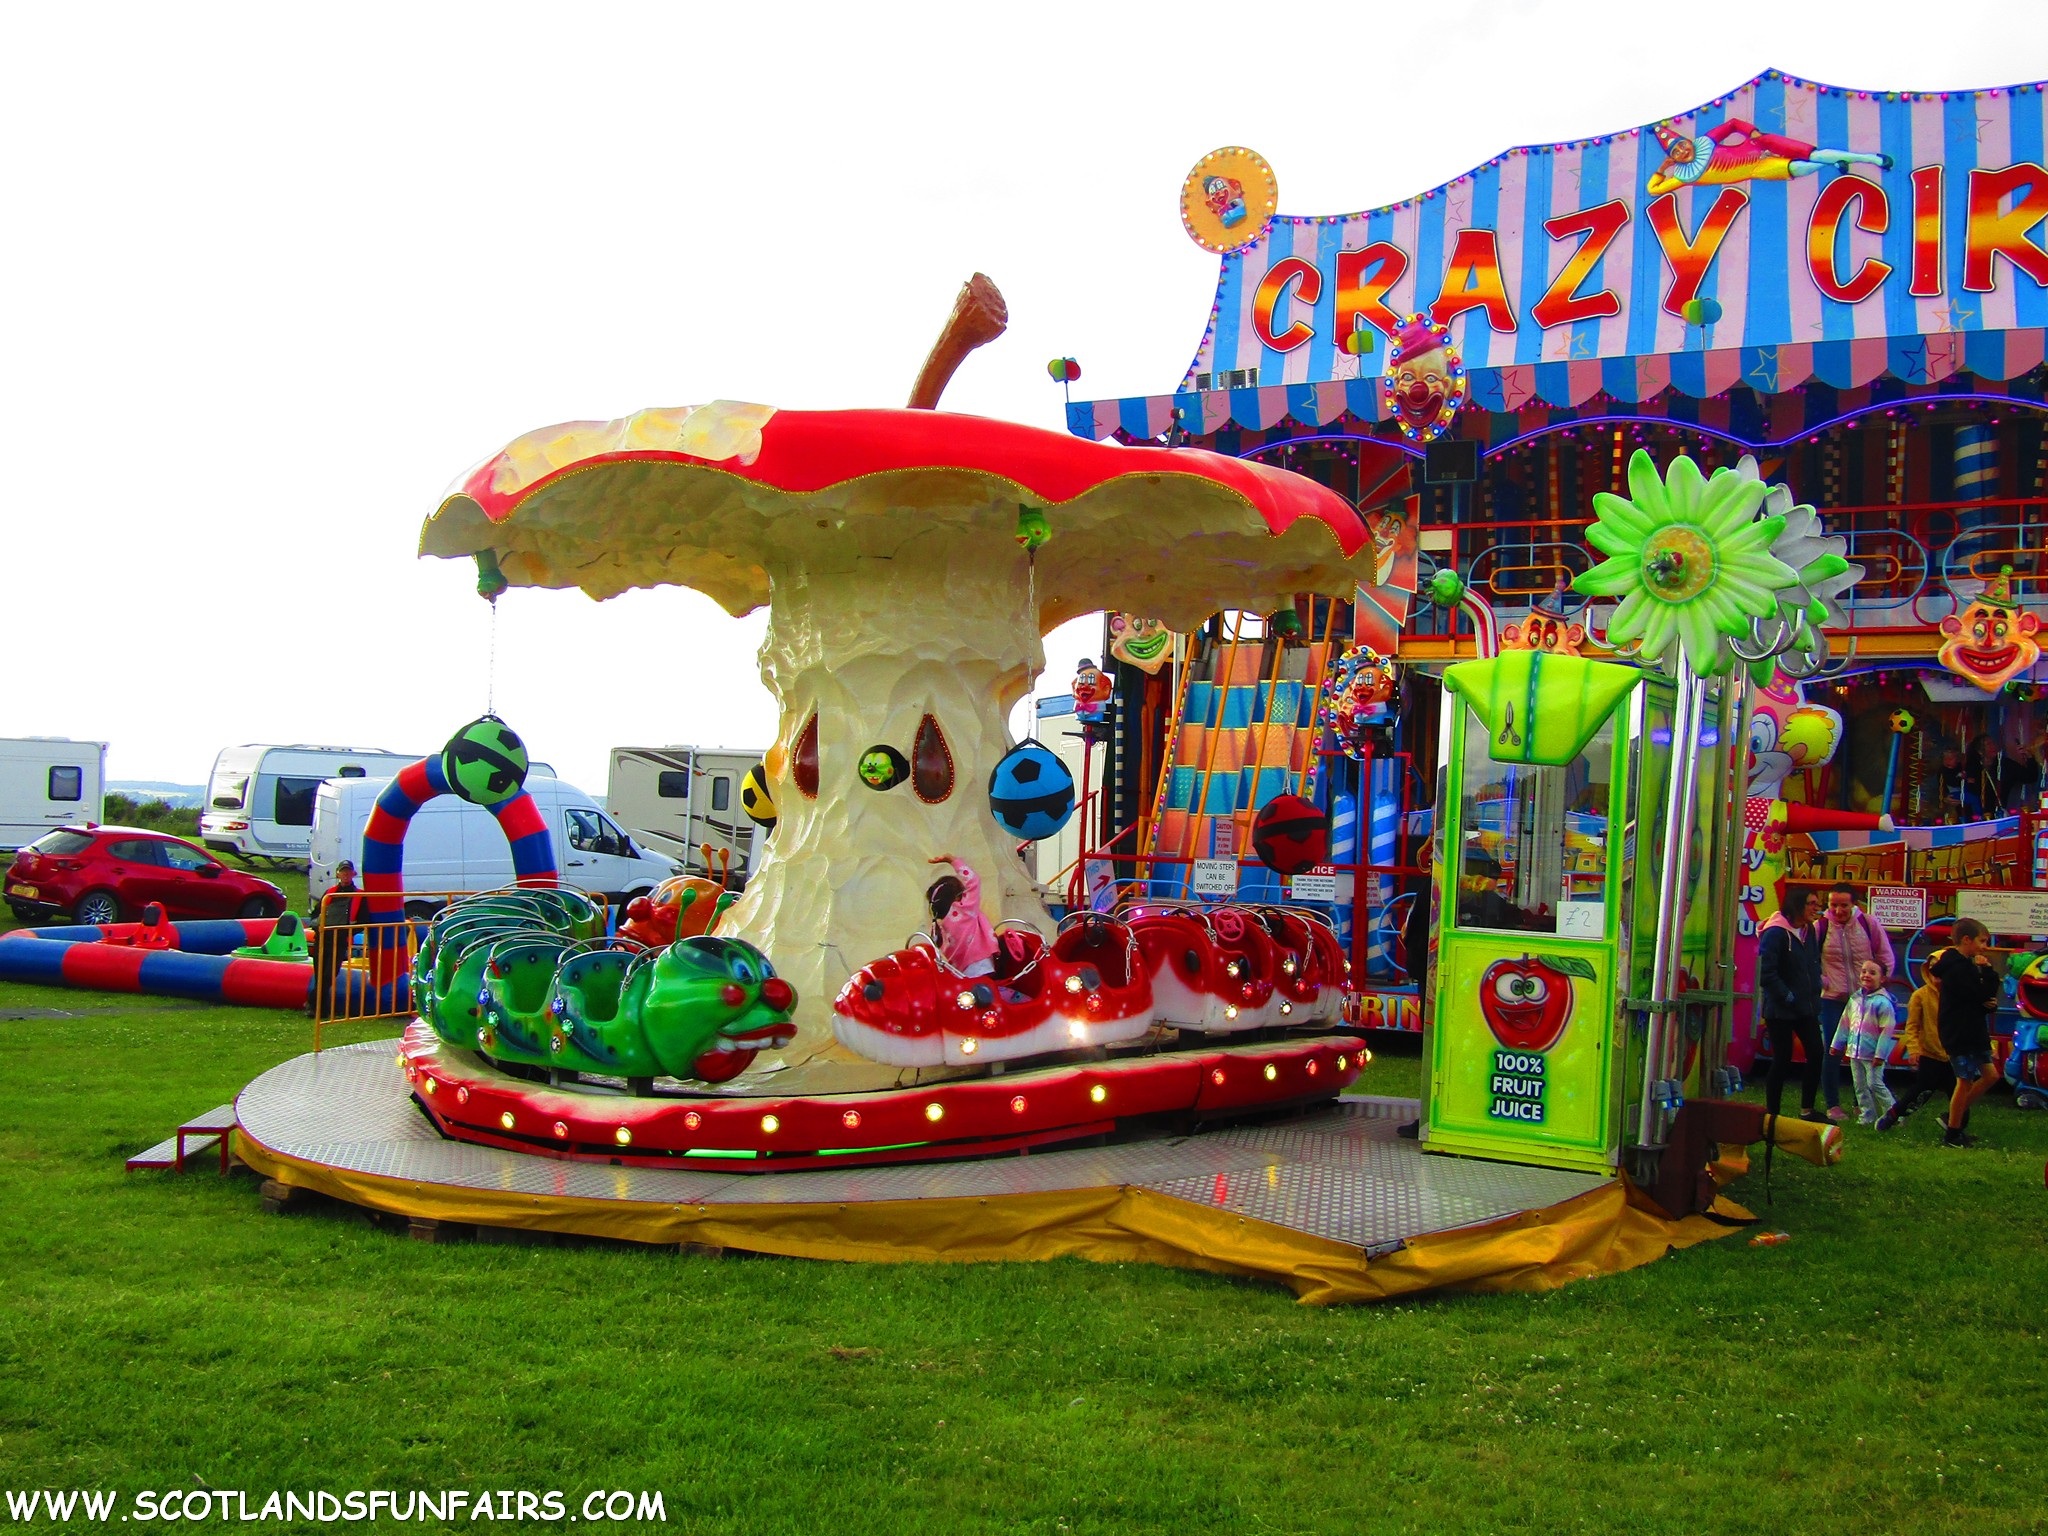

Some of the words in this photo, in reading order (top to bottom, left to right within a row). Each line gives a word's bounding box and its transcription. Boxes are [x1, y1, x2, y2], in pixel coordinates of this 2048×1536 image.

[1251, 186, 1749, 353] CRAZY
[1807, 161, 2048, 305] CIR
[1197, 861, 1217, 870] MOVING
[1220, 863, 1235, 871] STEPS
[1875, 888, 1919, 897] WARNING
[1565, 906, 1591, 928] £2
[1496, 1053, 1543, 1075] 100%
[1492, 1076, 1543, 1098] FRUIT
[1491, 1100, 1542, 1122] JUICE
